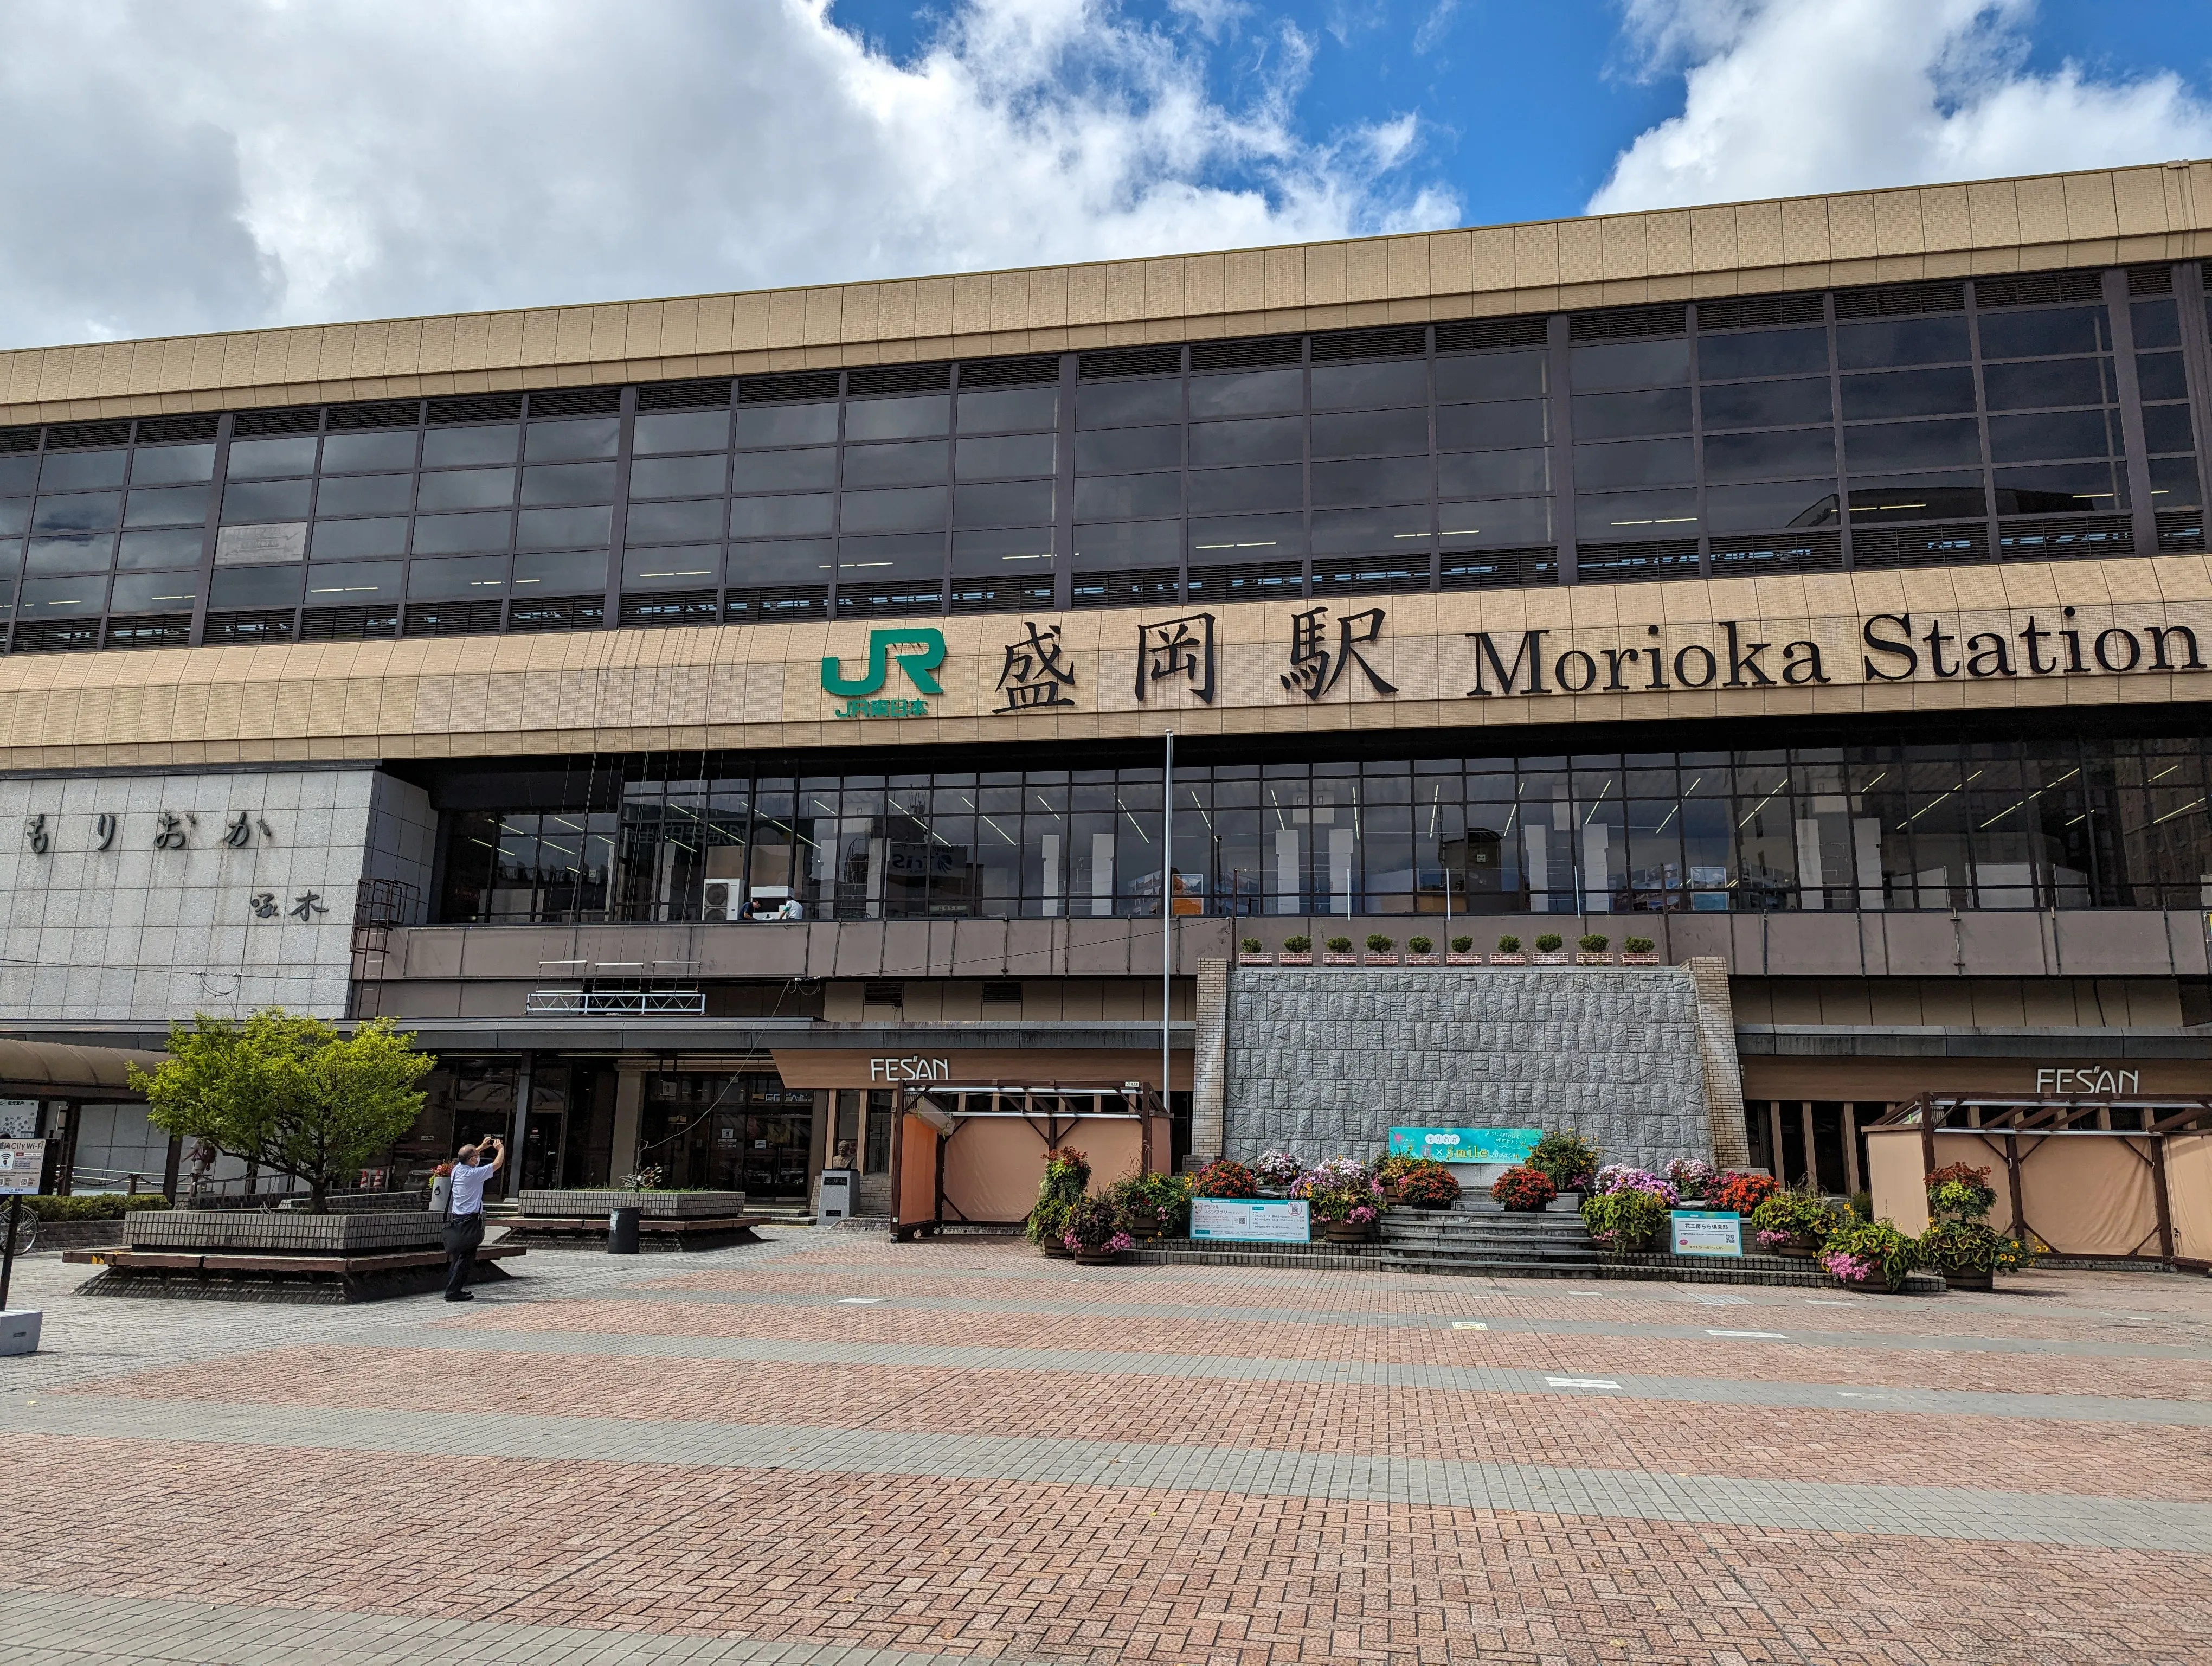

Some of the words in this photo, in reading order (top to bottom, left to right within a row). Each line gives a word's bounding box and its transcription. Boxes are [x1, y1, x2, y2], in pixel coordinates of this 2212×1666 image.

[821, 627, 946, 696] JR
[992, 606, 1399, 714] 盛岡駅
[1465, 621, 1832, 697] Morioka
[1862, 606, 2209, 682] Station
[835, 698, 929, 718] JR東日本
[27, 811, 272, 854] もりおか
[250, 889, 329, 921] 啄木
